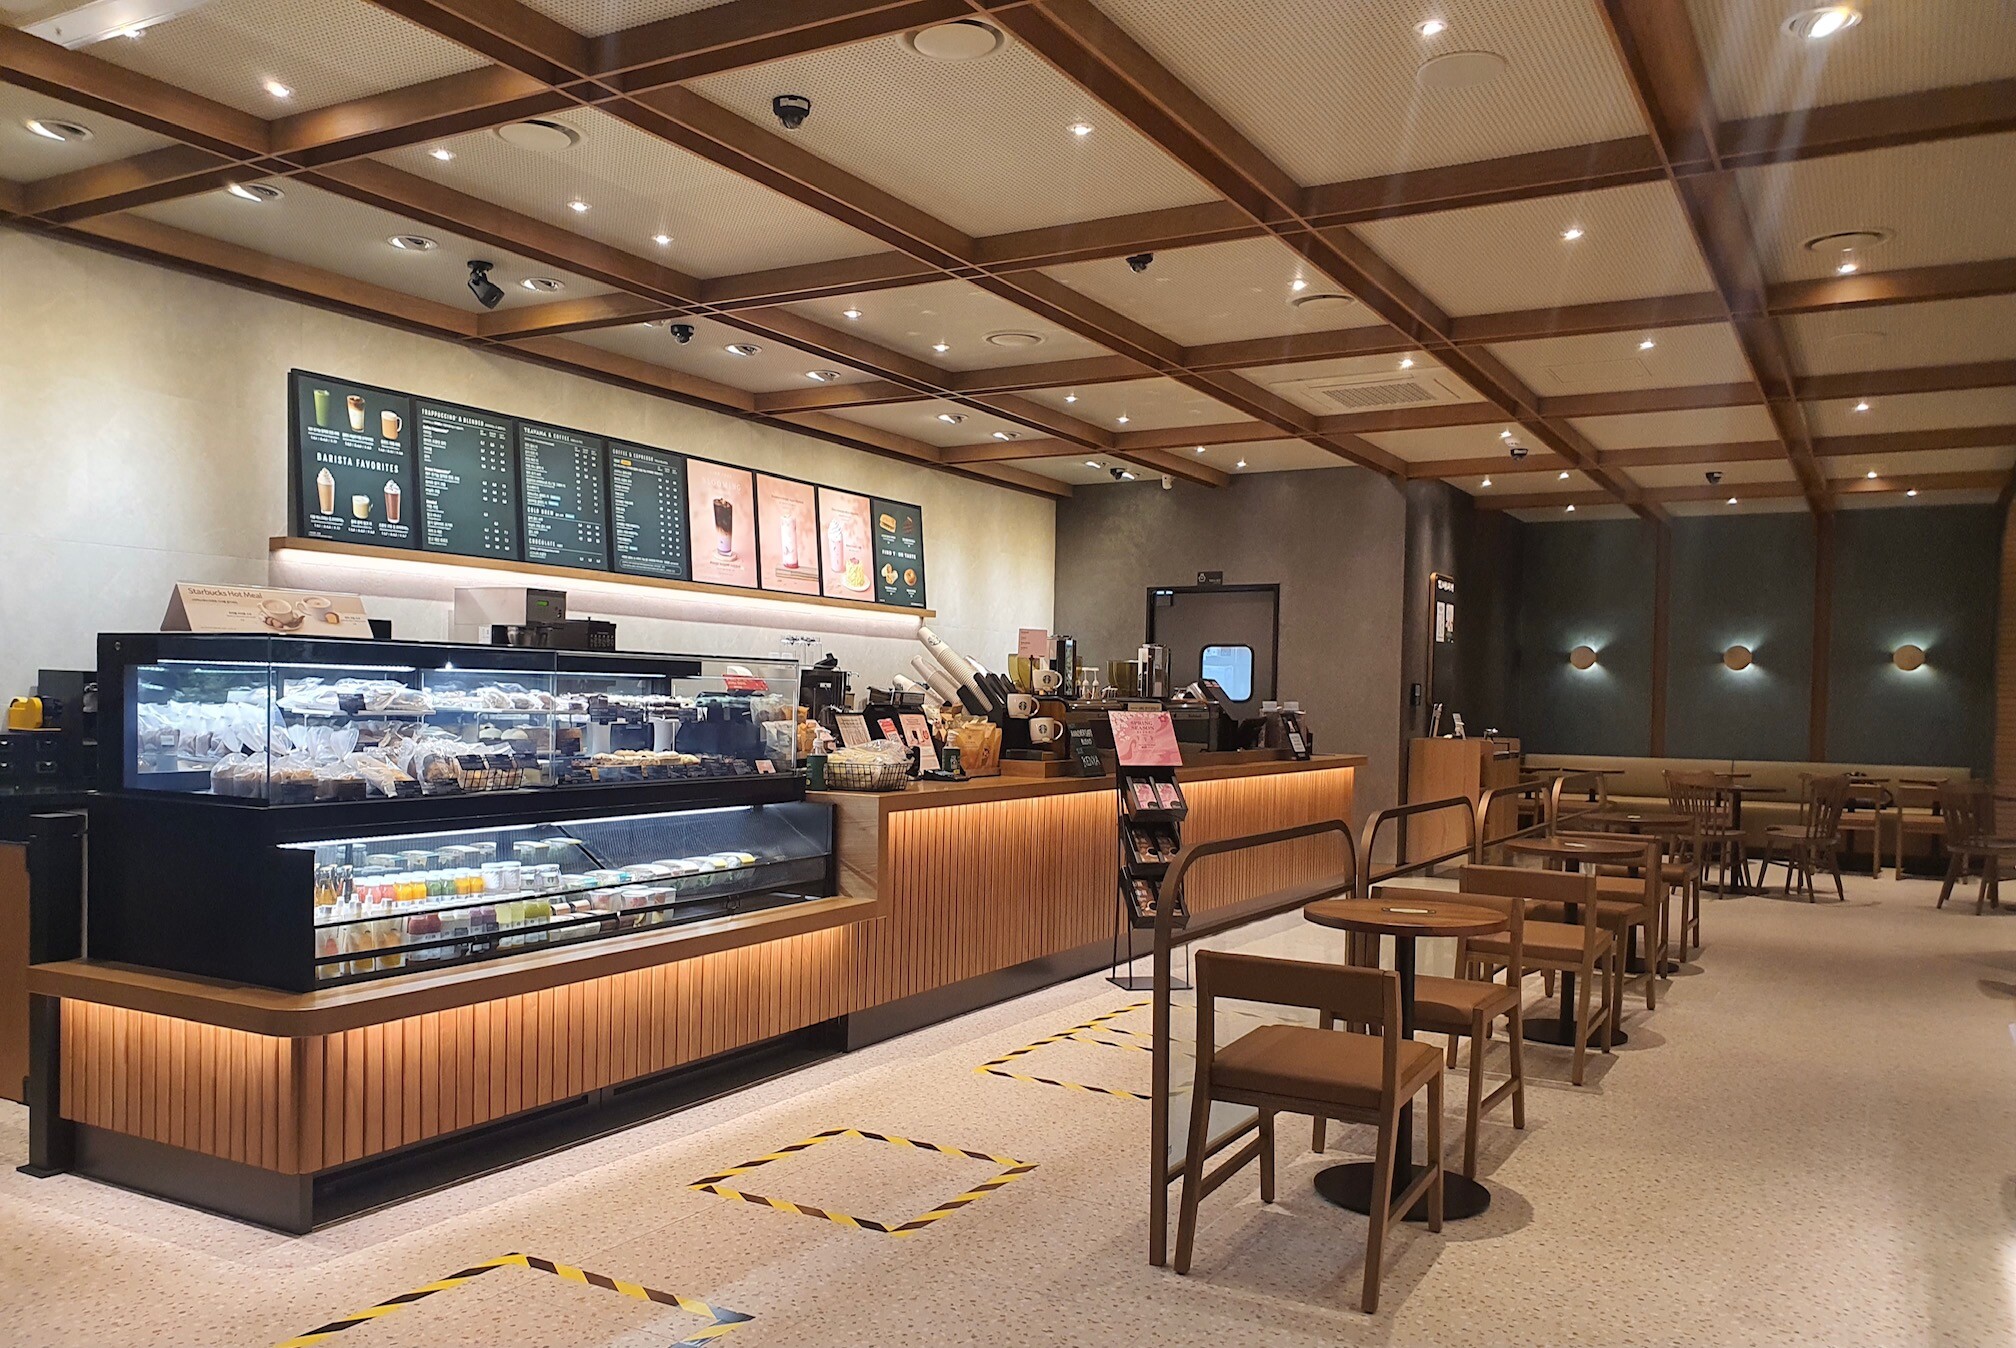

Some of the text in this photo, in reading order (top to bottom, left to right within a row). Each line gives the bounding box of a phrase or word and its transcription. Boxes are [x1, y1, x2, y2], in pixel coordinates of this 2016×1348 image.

[524, 427, 547, 437] TEAVANA
[317, 452, 399, 473] BARISTA FAVORITES
[527, 506, 539, 514] COLD
[529, 538, 555, 547] CHOCOLATE
[188, 588, 227, 597] Starbucks
[228, 590, 242, 598] Hot
